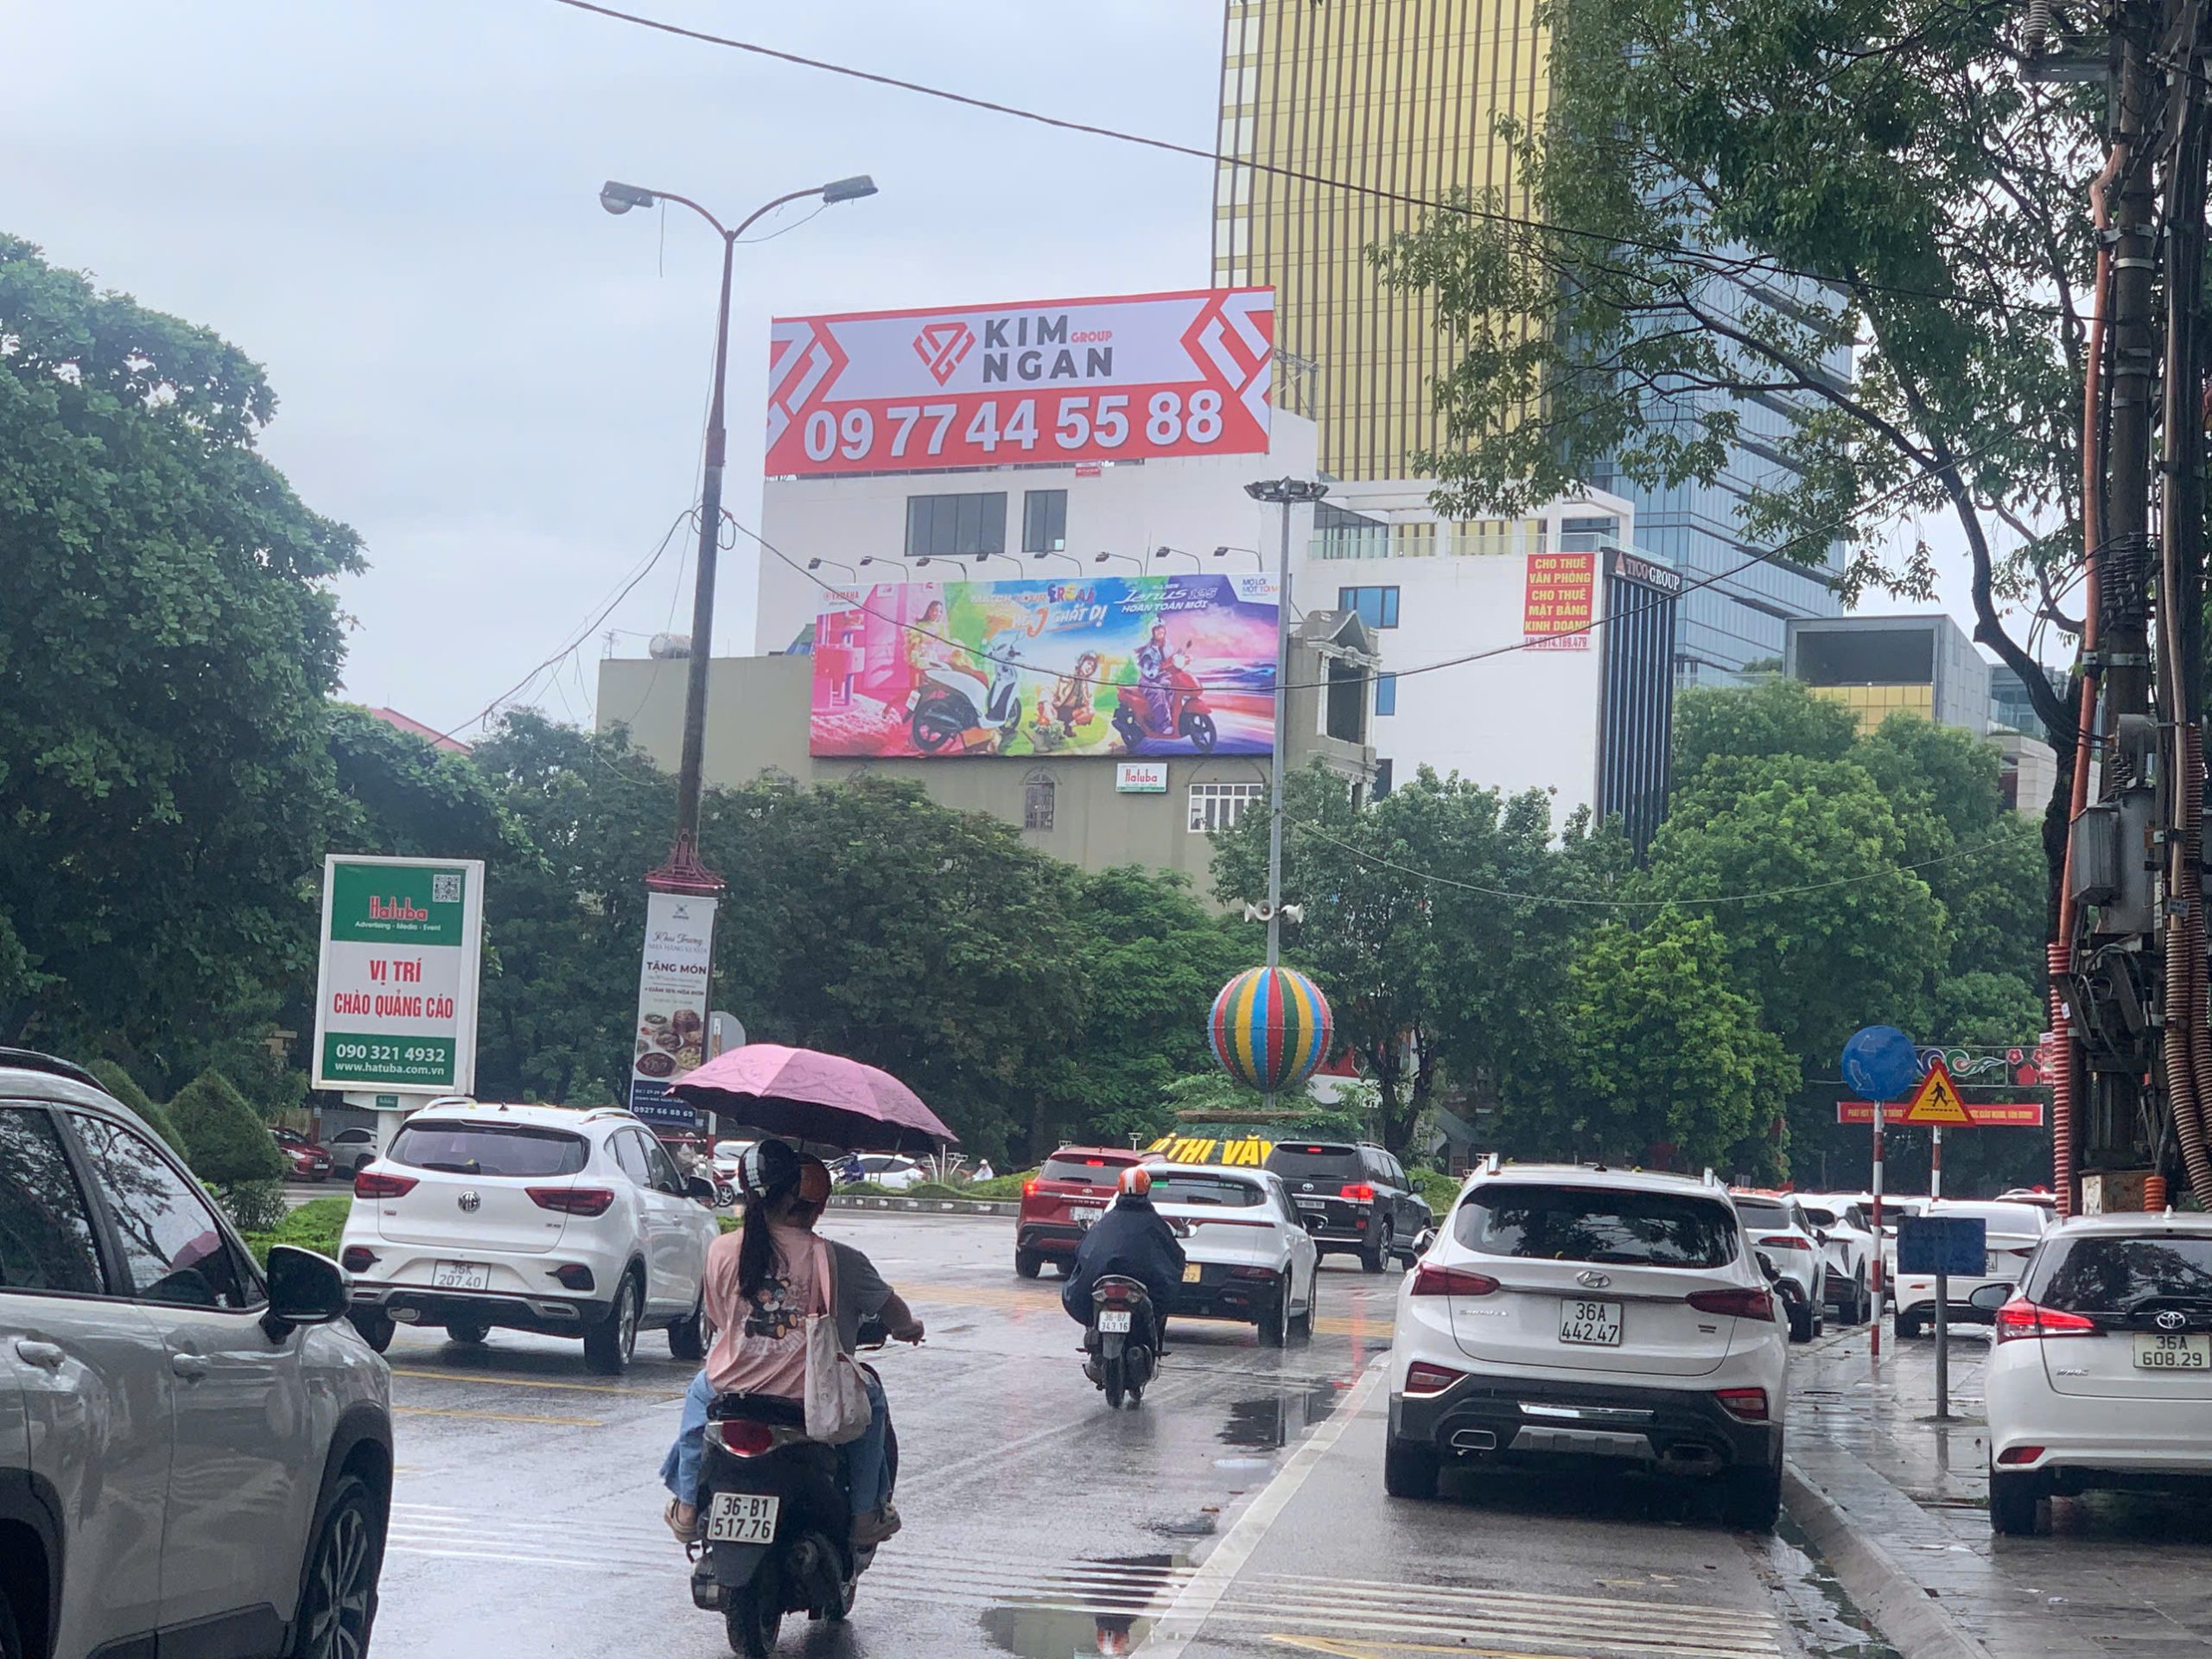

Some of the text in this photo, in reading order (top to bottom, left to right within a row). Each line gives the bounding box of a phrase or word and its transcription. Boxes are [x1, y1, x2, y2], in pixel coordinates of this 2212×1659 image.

[984, 315, 1112, 348] KIM GROUP
[982, 347, 1112, 383] NGAN
[804, 389, 1223, 461] 09 77 44 55 88
[1535, 556, 1586, 569] CHO THUÊ
[1529, 570, 1591, 584] VĂN PHÒNG
[1649, 567, 1680, 590] GROUP
[1532, 588, 1586, 601] CHO THUÊ
[1524, 620, 1590, 632] KINH DOANH
[370, 895, 428, 921] Hatuba
[370, 958, 422, 985] VỊ TRÍ
[680, 963, 707, 975] MÓN
[334, 988, 453, 1019] CHÀO QUẢNG CÁO
[336, 1044, 445, 1062] 090 321 4932
[335, 1062, 444, 1076] www.hatuba.com.vn
[439, 1274, 481, 1287] 207.40
[1575, 1303, 1605, 1322] 36A
[1561, 1321, 1618, 1342] 442.47
[2156, 1336, 2188, 1350] 36A
[2142, 1351, 2202, 1366] 608.29
[722, 1497, 768, 1518] 36-B1
[714, 1517, 771, 1539] 517.76
